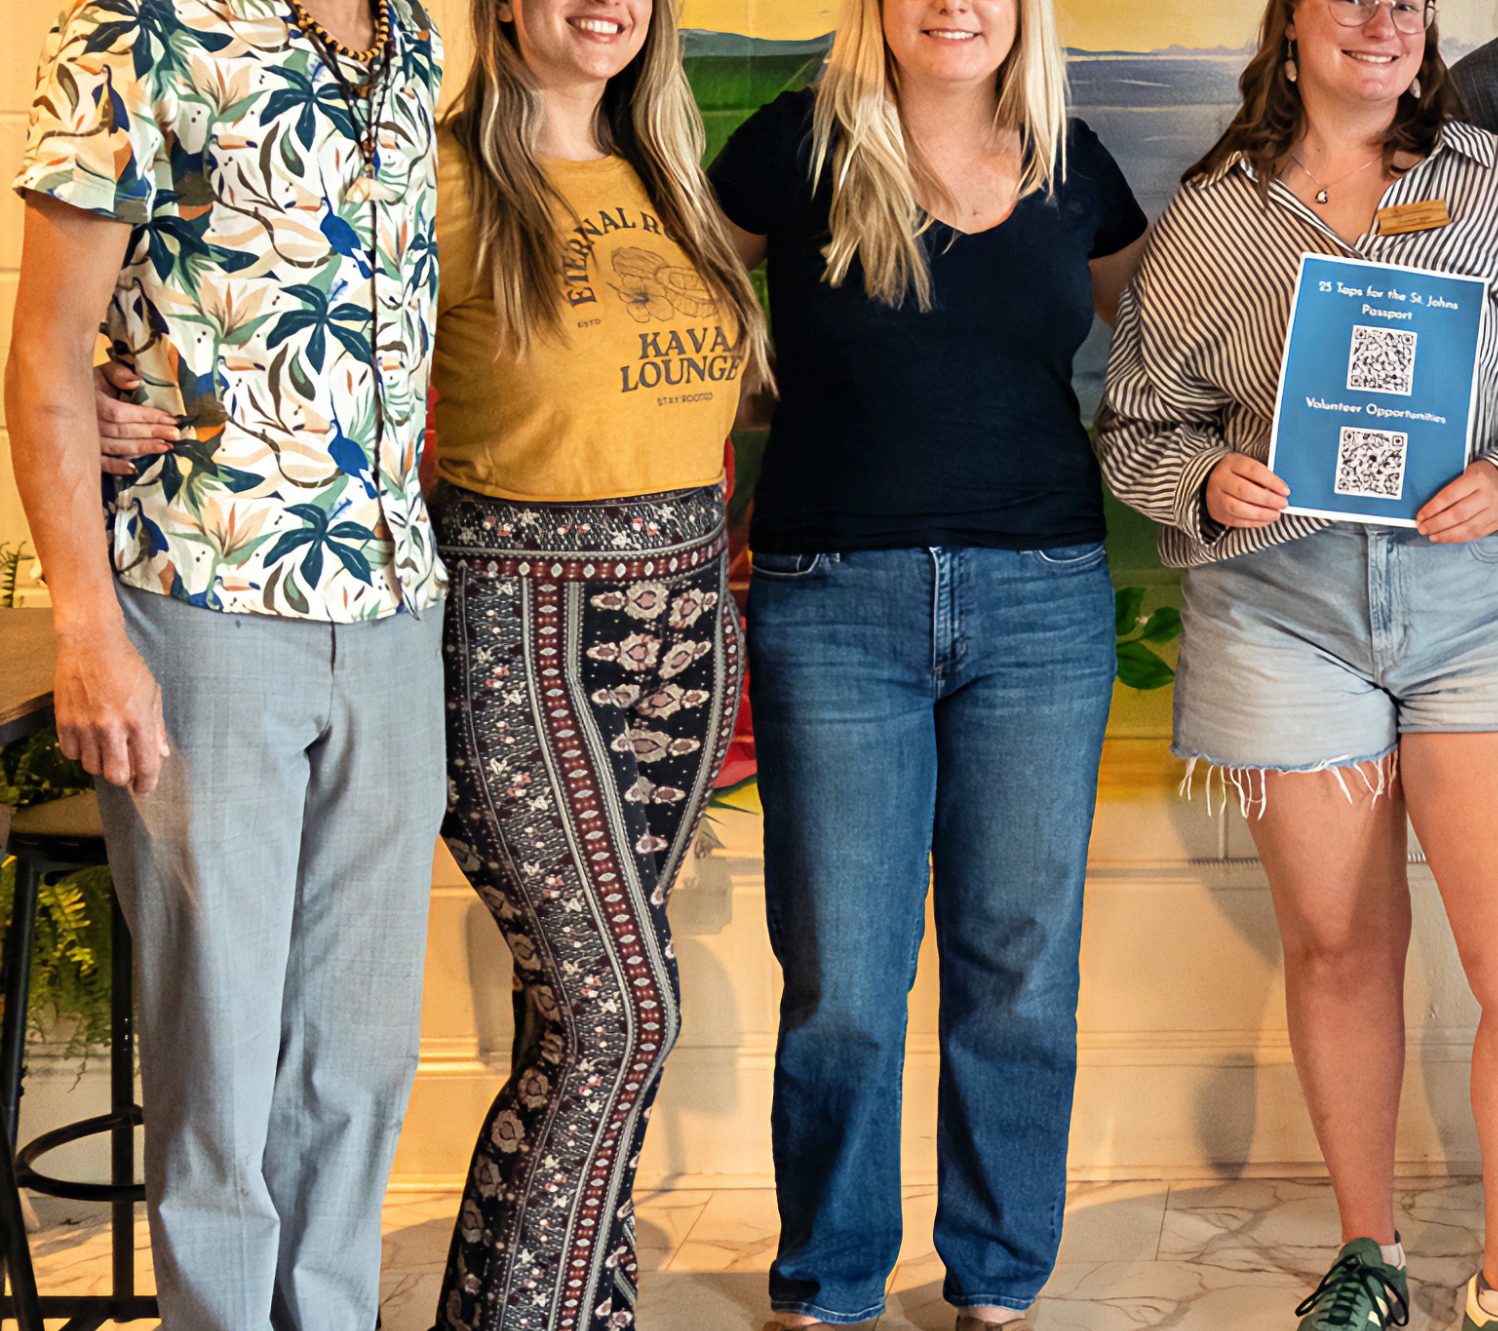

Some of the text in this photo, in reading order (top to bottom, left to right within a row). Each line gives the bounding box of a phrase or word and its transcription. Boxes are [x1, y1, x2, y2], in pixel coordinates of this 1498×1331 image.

[562, 207, 637, 308] ETERNAL
[1361, 303, 1413, 320] Passport
[1366, 285, 1384, 298] for
[1387, 288, 1406, 301] the
[1426, 295, 1459, 310] Johns
[638, 326, 733, 360] KAVA
[620, 355, 742, 393] LOUNGE
[1305, 396, 1447, 424] Volunteer Opportunities
